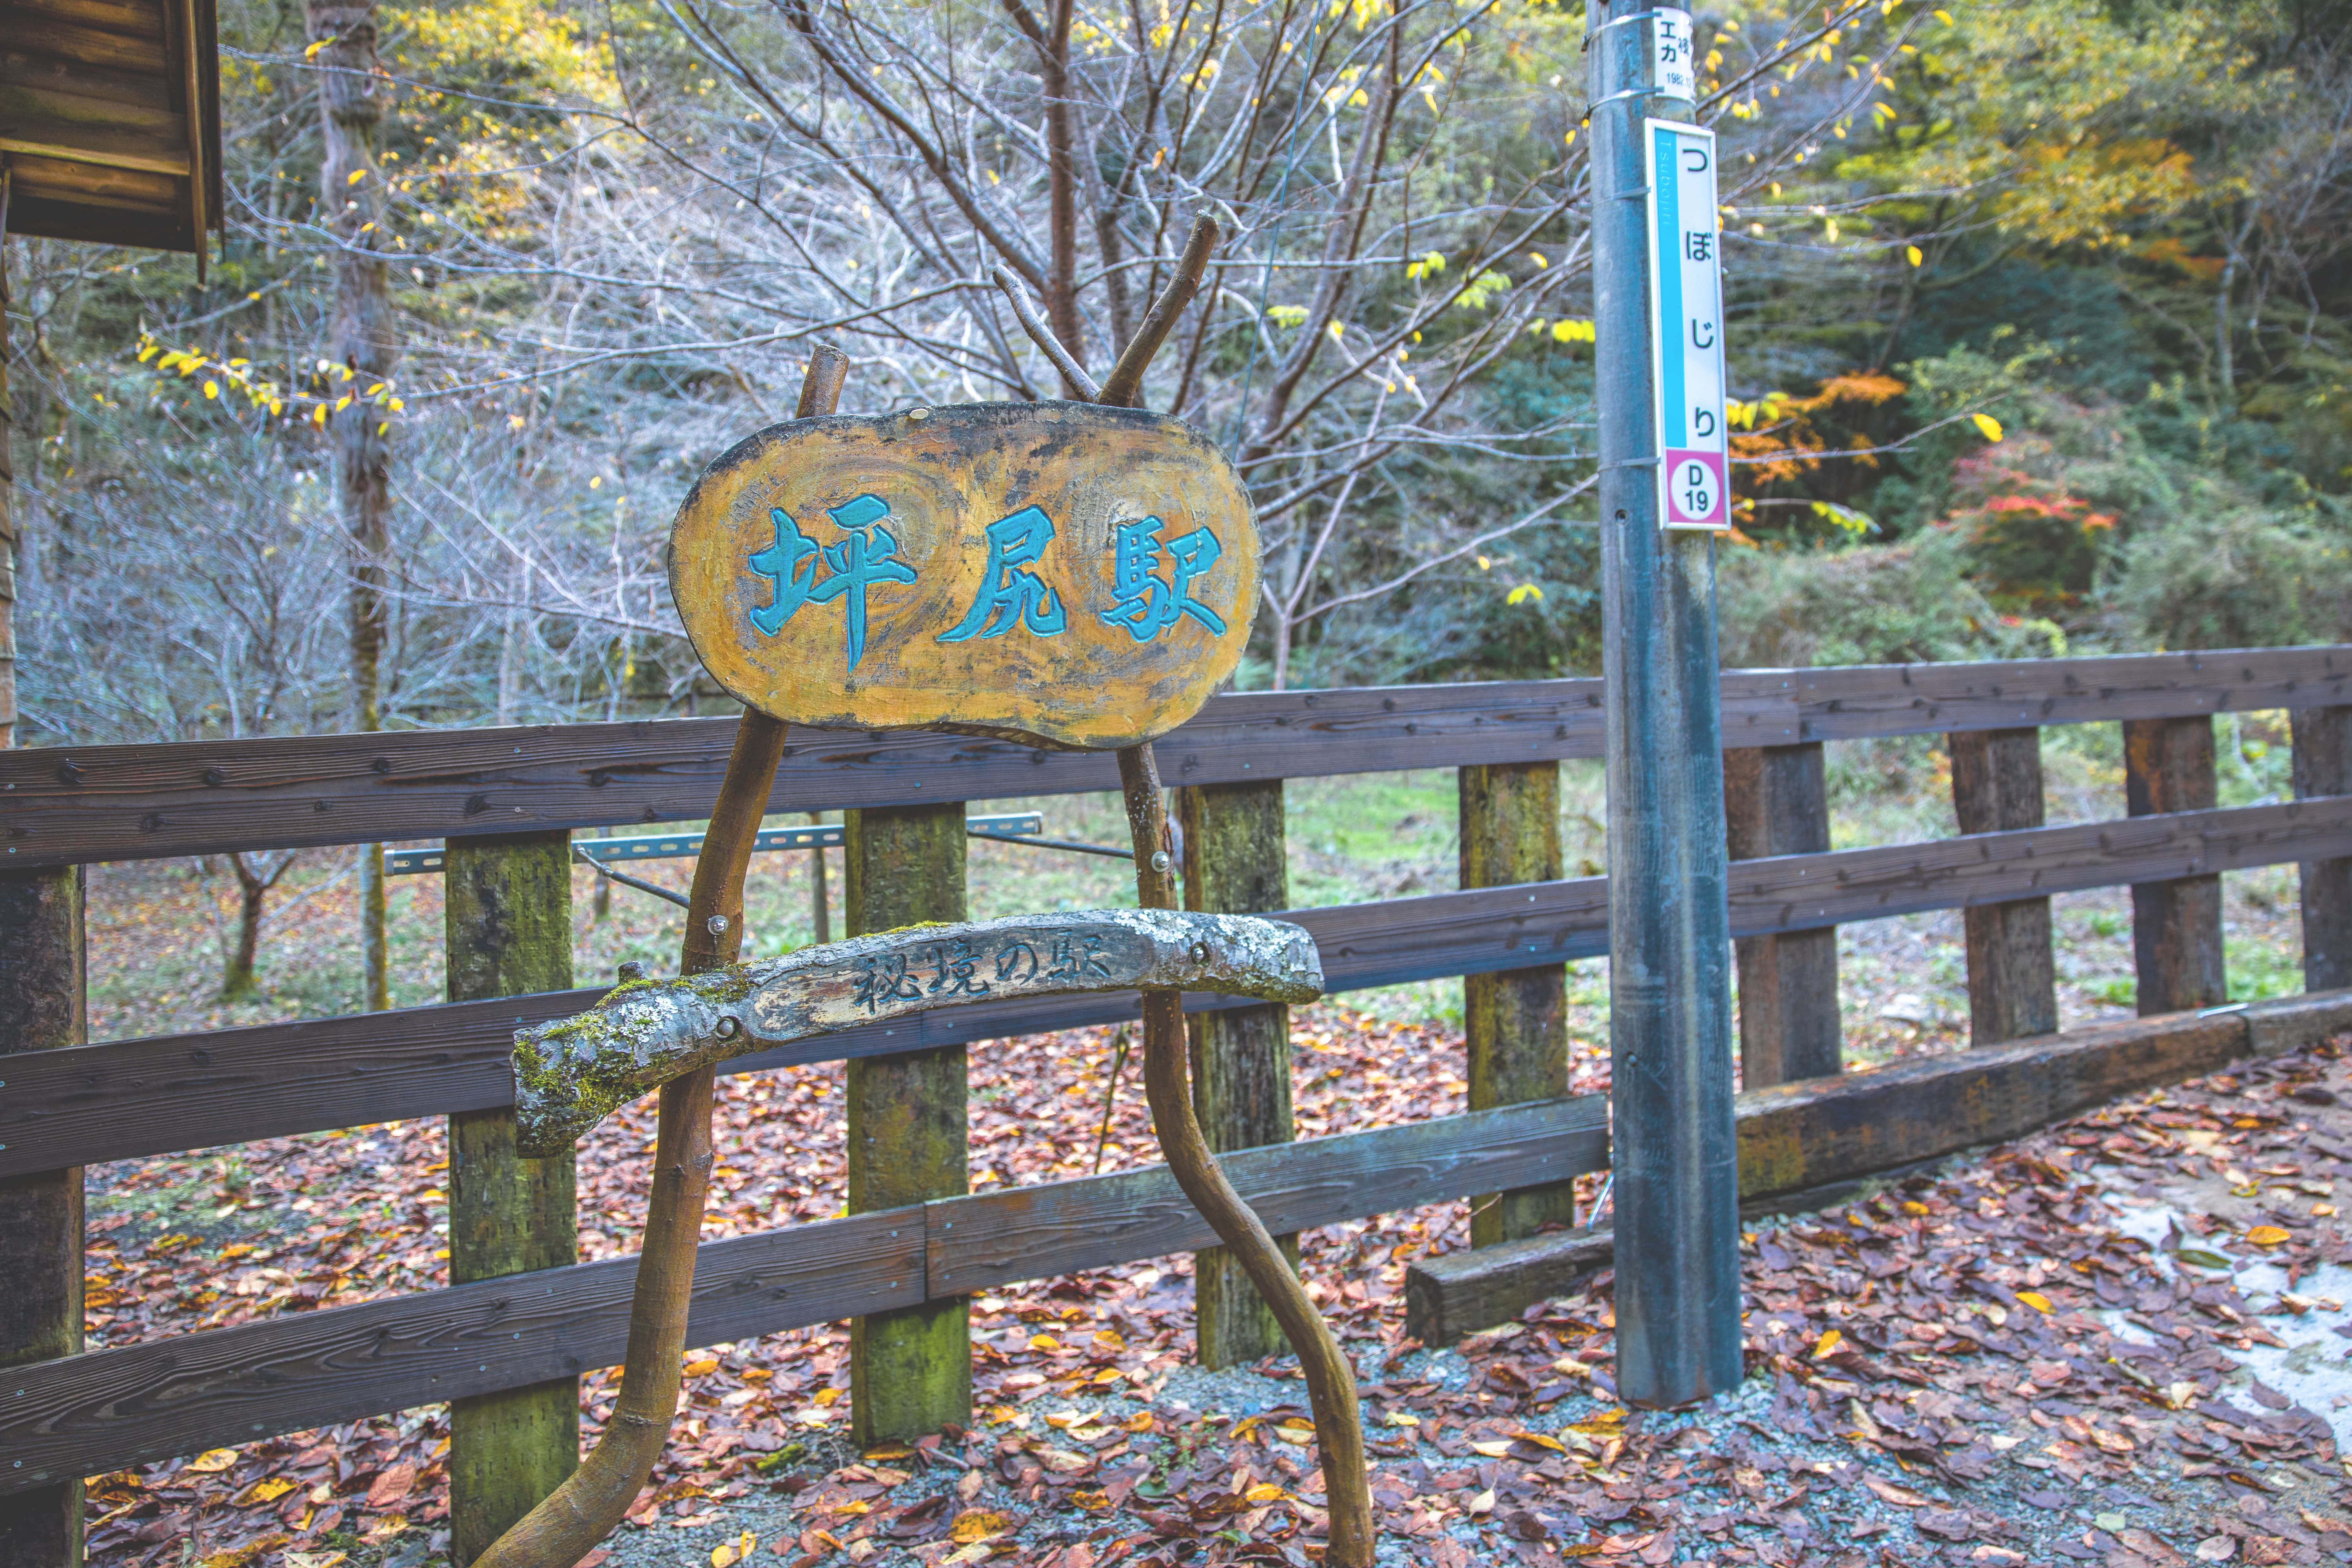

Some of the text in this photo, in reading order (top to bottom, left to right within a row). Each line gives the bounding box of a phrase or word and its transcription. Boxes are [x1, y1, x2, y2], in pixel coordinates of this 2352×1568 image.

[1682, 148, 1715, 437] つぼじり
[1686, 490, 1709, 512] 19
[1689, 465, 1704, 486] D
[748, 493, 1227, 673] 坪尻駅
[852, 929, 1112, 1016] 秘境の駅
